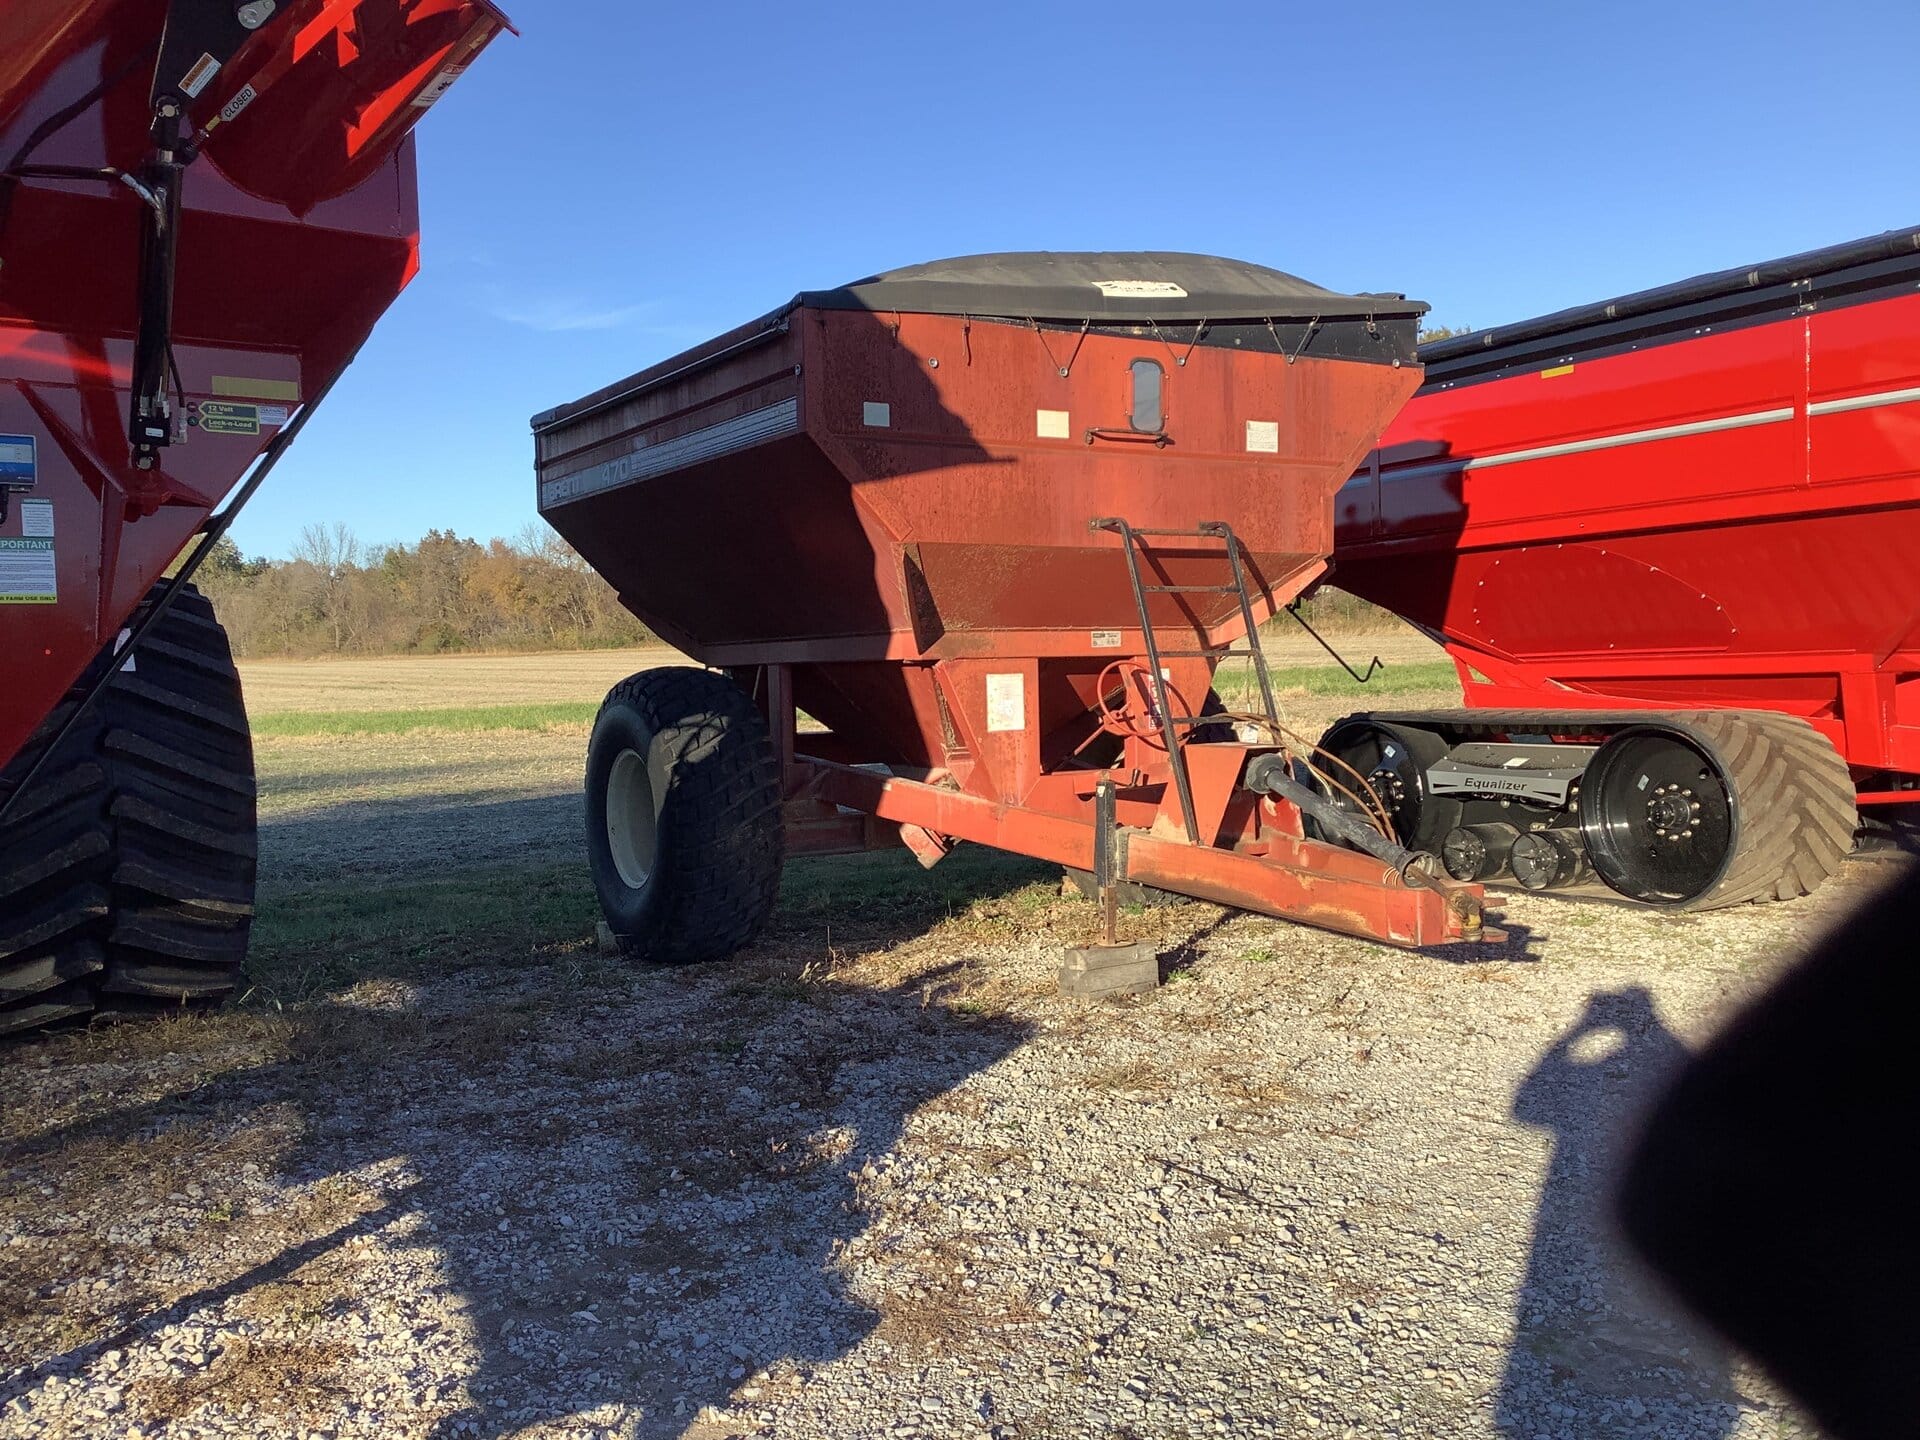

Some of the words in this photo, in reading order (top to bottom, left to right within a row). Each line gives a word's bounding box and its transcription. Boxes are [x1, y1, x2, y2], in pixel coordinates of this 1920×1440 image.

[224, 88, 252, 118] CLOSED
[218, 405, 234, 413] Volt
[208, 419, 253, 428] Lock-n-Load
[602, 457, 629, 484] 470
[0, 540, 54, 549] PORTANT
[1464, 777, 1528, 791] Equalizer
